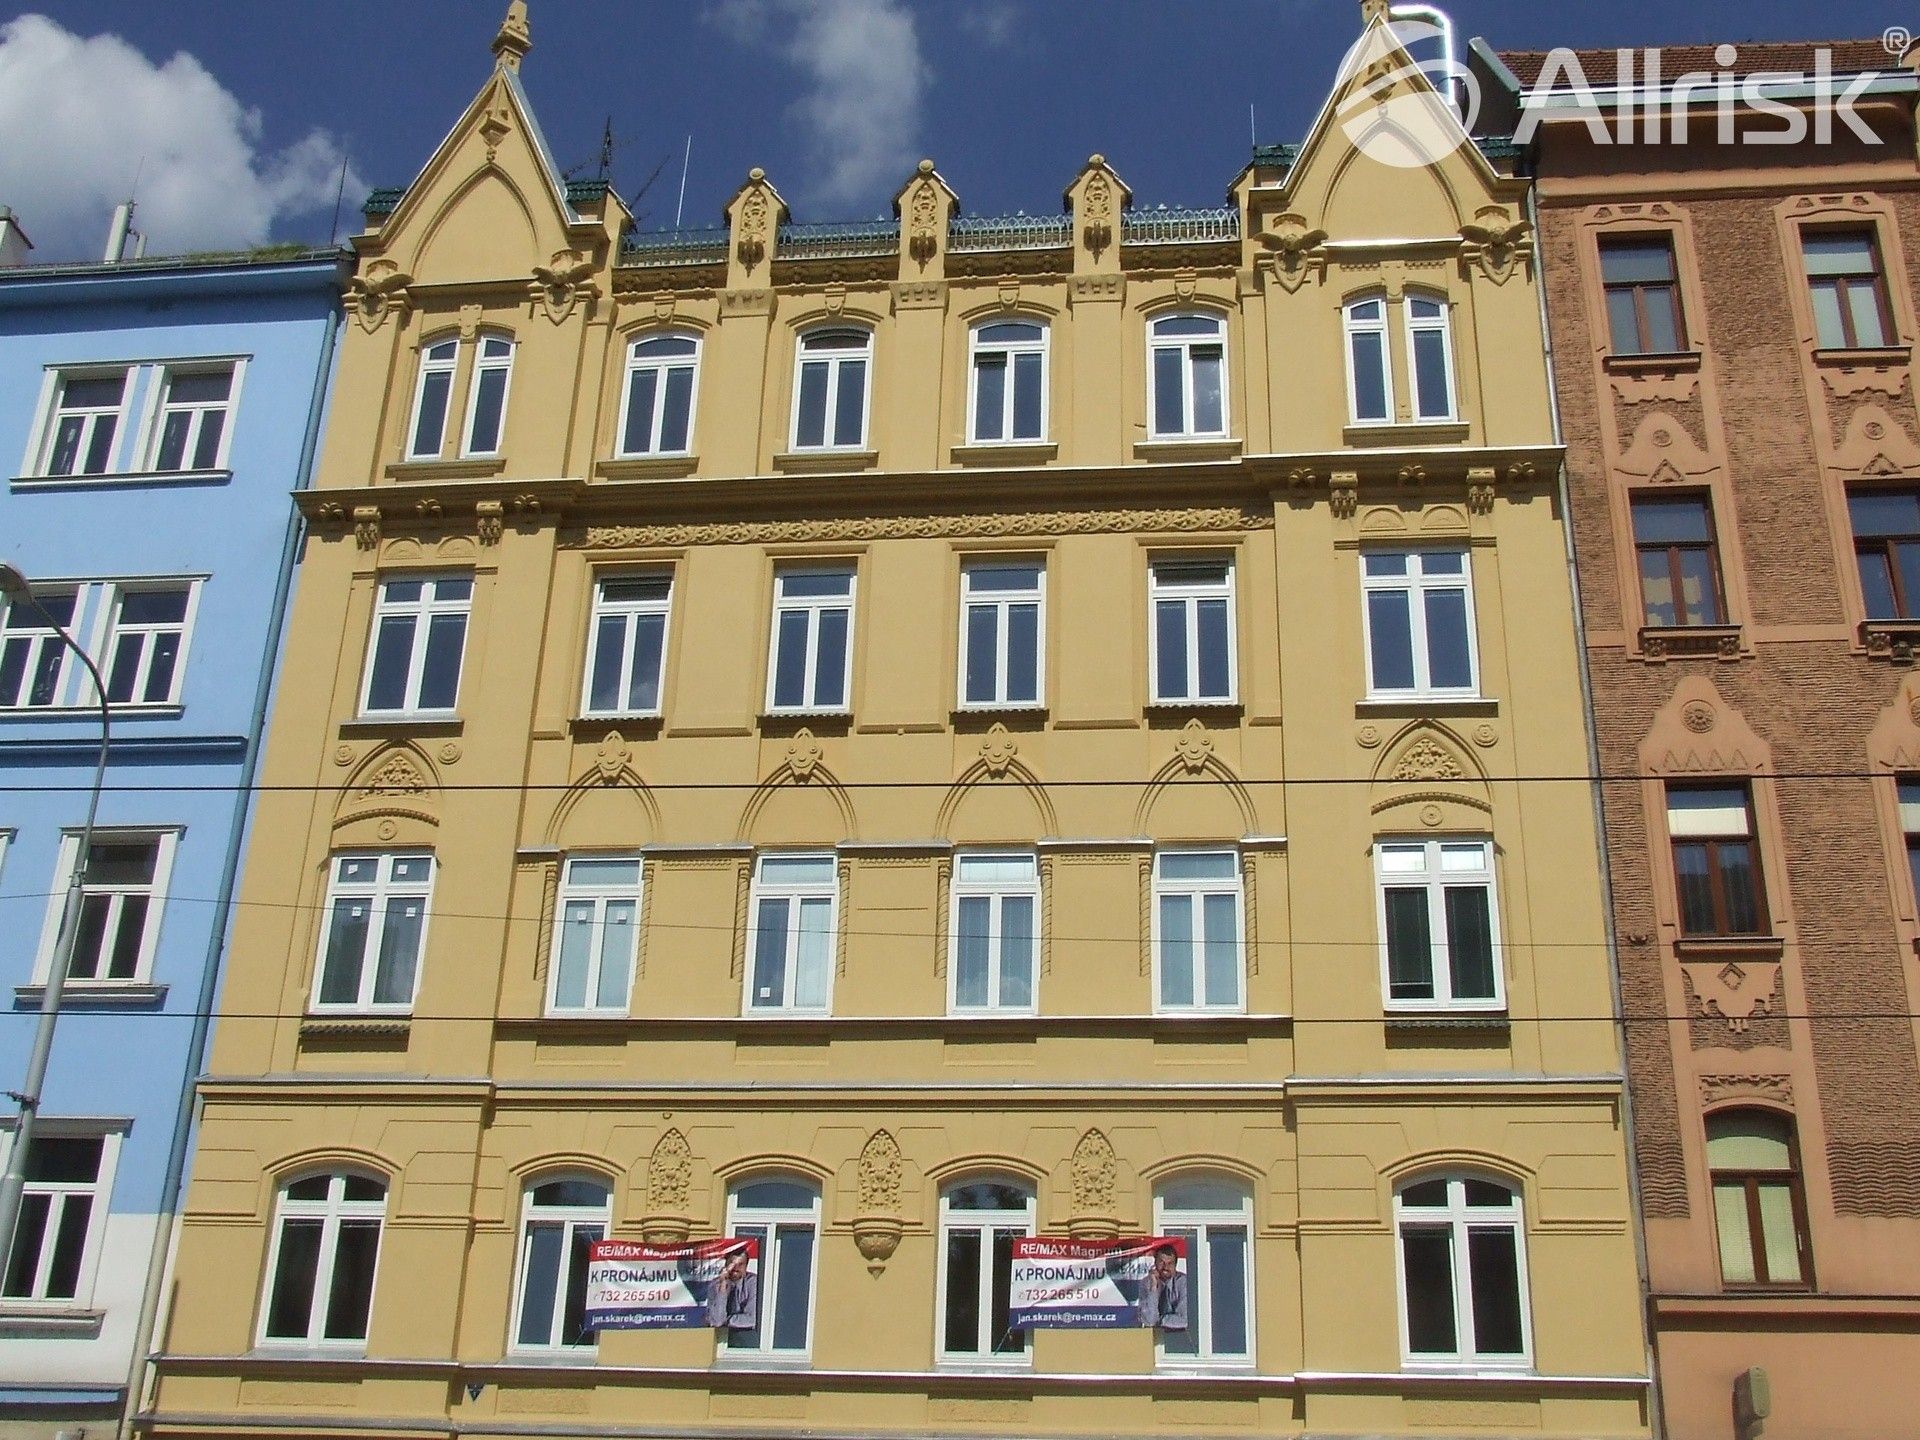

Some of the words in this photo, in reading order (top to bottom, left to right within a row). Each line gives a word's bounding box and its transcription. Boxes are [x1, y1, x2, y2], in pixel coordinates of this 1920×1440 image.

[597, 1245, 641, 1257] RE/MAX
[643, 1247, 694, 1258] Magnum
[1020, 1243, 1067, 1256] RE/MAX
[590, 1270, 599, 1283] K
[600, 1267, 677, 1283] PRONÁJMU
[1014, 1268, 1024, 1281] K
[1026, 1265, 1106, 1281] PRONÁJMU
[600, 1290, 620, 1301] 732
[623, 1290, 645, 1301] 265
[647, 1289, 671, 1301] 510
[1025, 1288, 1047, 1301] 732
[1050, 1288, 1073, 1300] 265
[1076, 1288, 1099, 1300] 510
[591, 1312, 685, 1326] jan.skarek@re-max.cz
[1017, 1311, 1117, 1325] jan.skarek@re-max.cz
